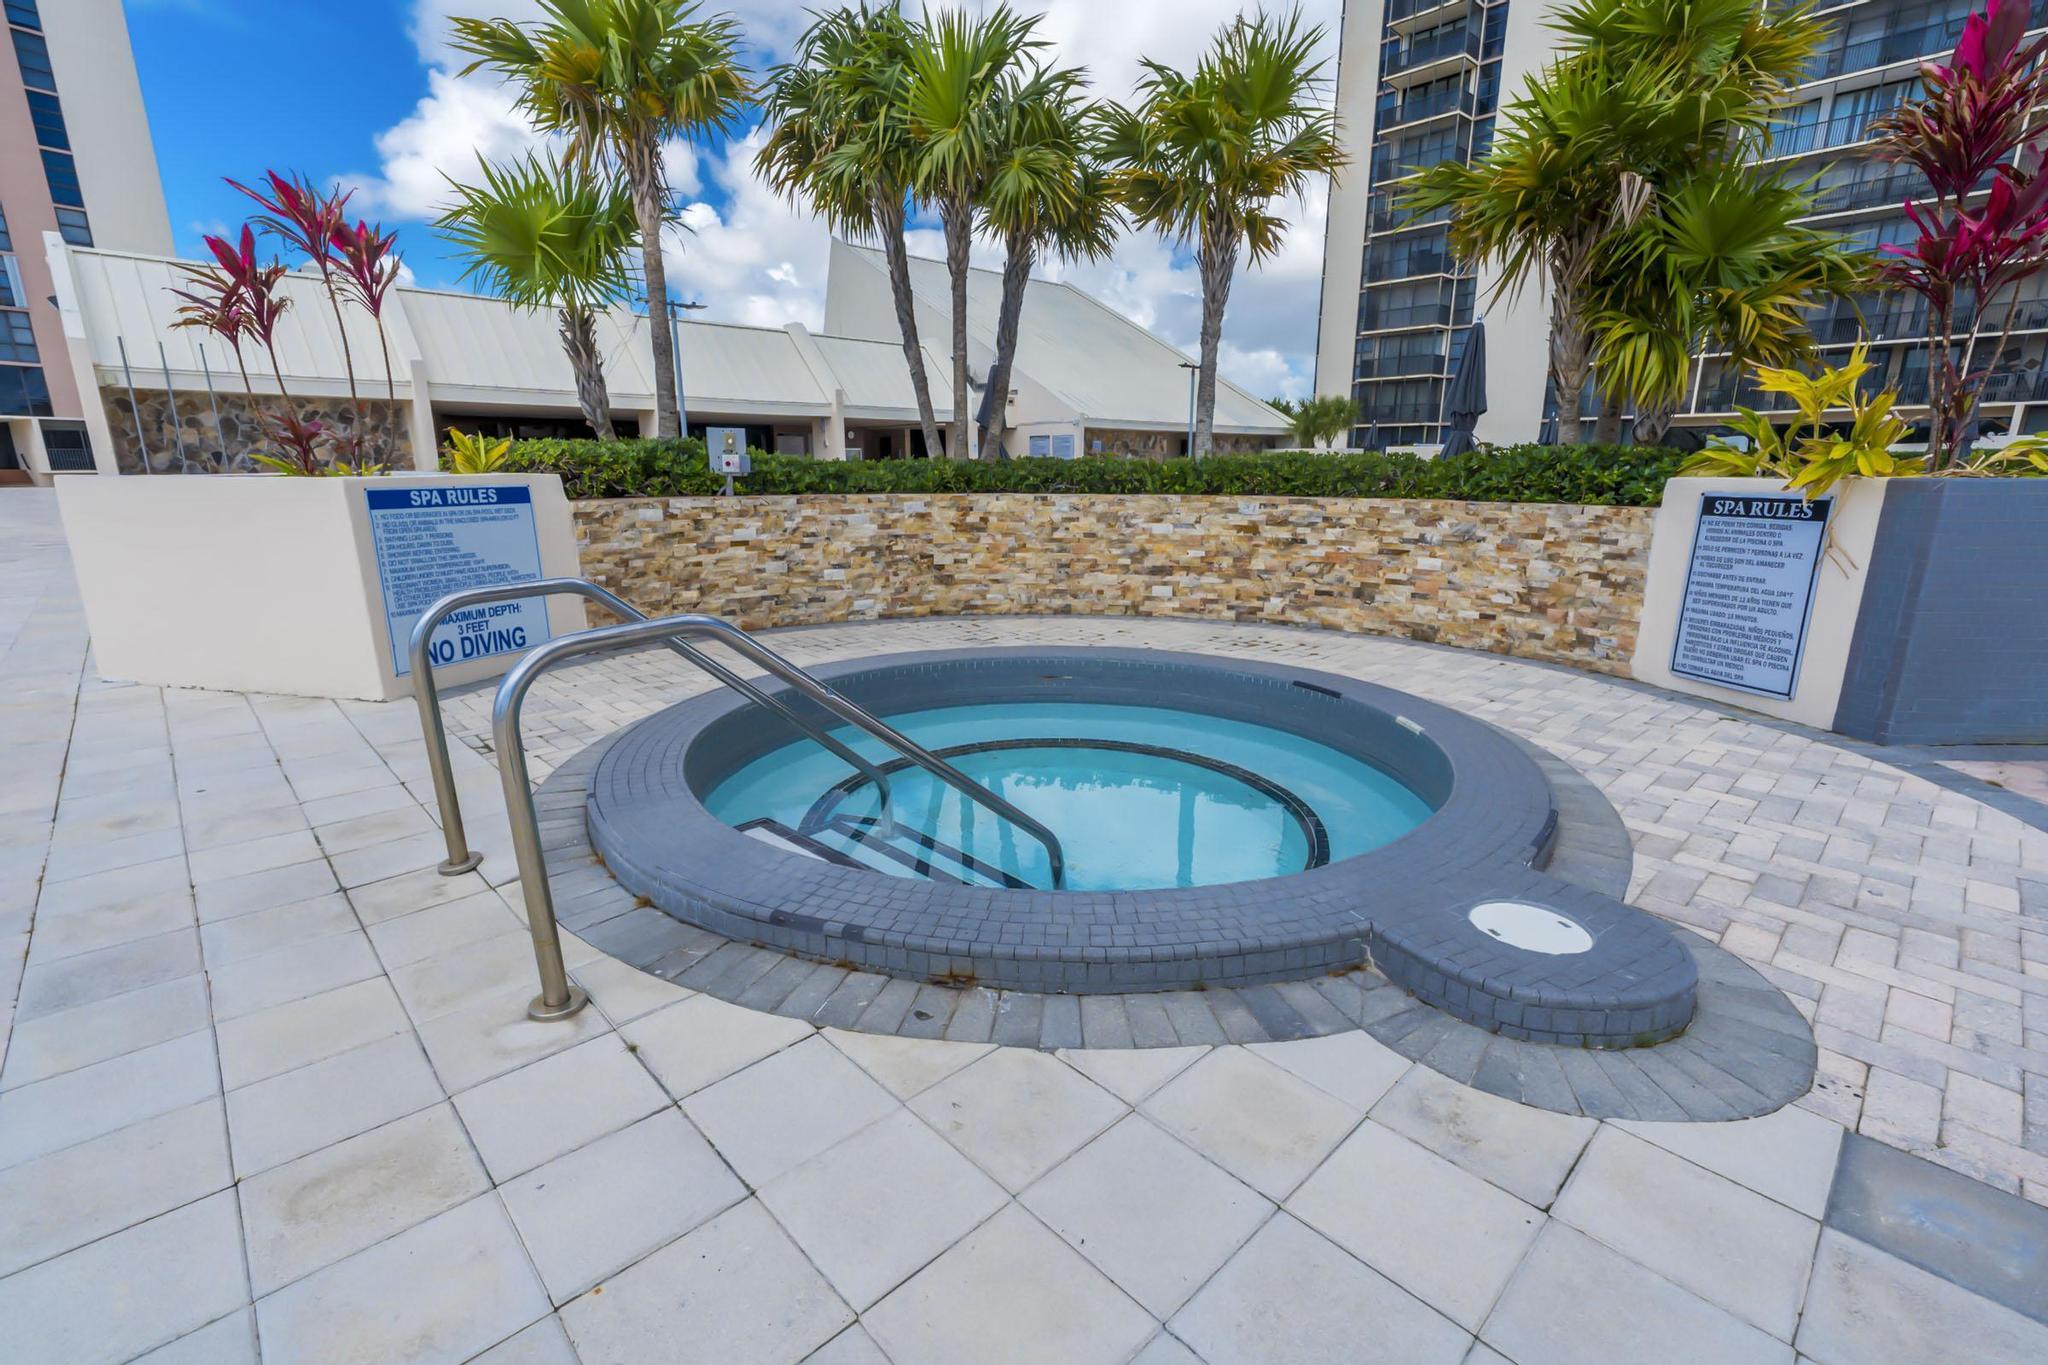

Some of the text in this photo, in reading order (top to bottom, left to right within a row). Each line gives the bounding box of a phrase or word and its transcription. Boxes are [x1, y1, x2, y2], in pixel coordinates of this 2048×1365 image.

[410, 488, 497, 505] SPA RULES
[1714, 500, 1813, 518] SPA RULES
[489, 603, 522, 617] DEPTH:
[458, 620, 490, 635] 3 FEET
[461, 626, 526, 658] DIVING
